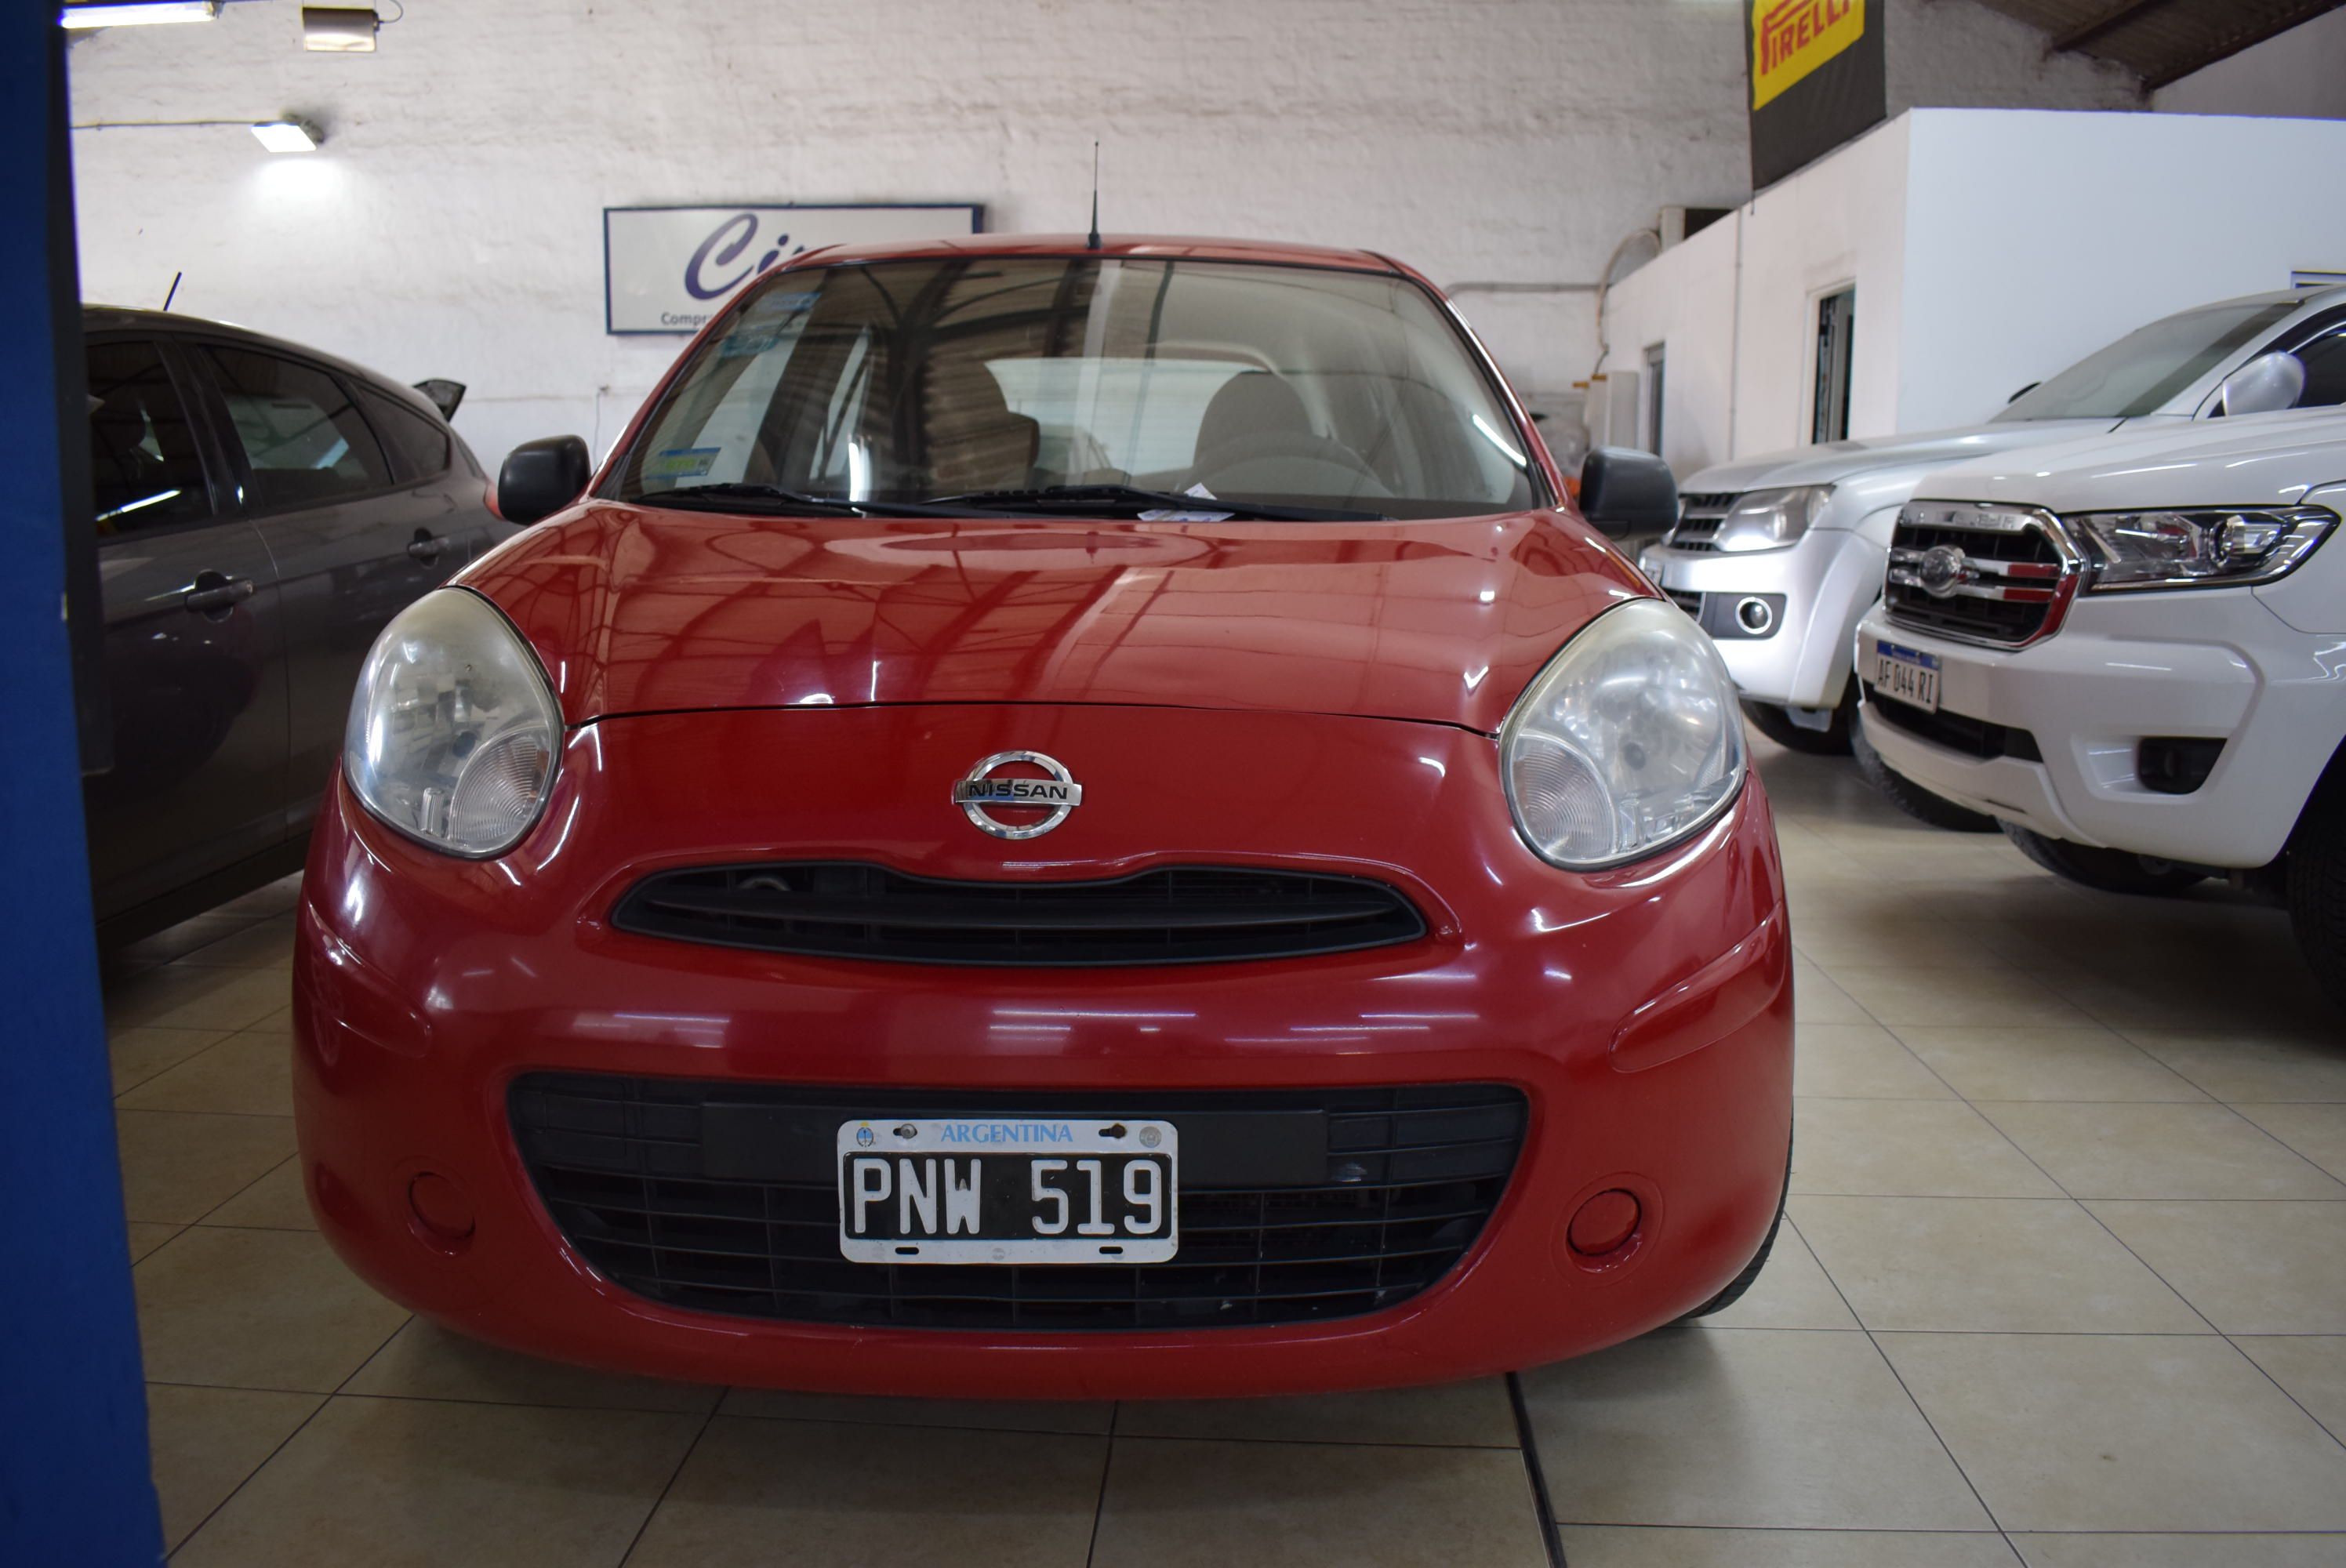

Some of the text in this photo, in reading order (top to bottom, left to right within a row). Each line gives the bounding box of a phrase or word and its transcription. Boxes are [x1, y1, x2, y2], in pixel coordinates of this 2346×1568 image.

[685, 212, 805, 300] Ci
[660, 311, 711, 327] Compr
[1877, 659, 1934, 703] AF 044 RI
[968, 783, 1068, 800] NISSAN
[941, 1123, 1073, 1143] ARGENTINA
[853, 1158, 1163, 1235] PNW 519
